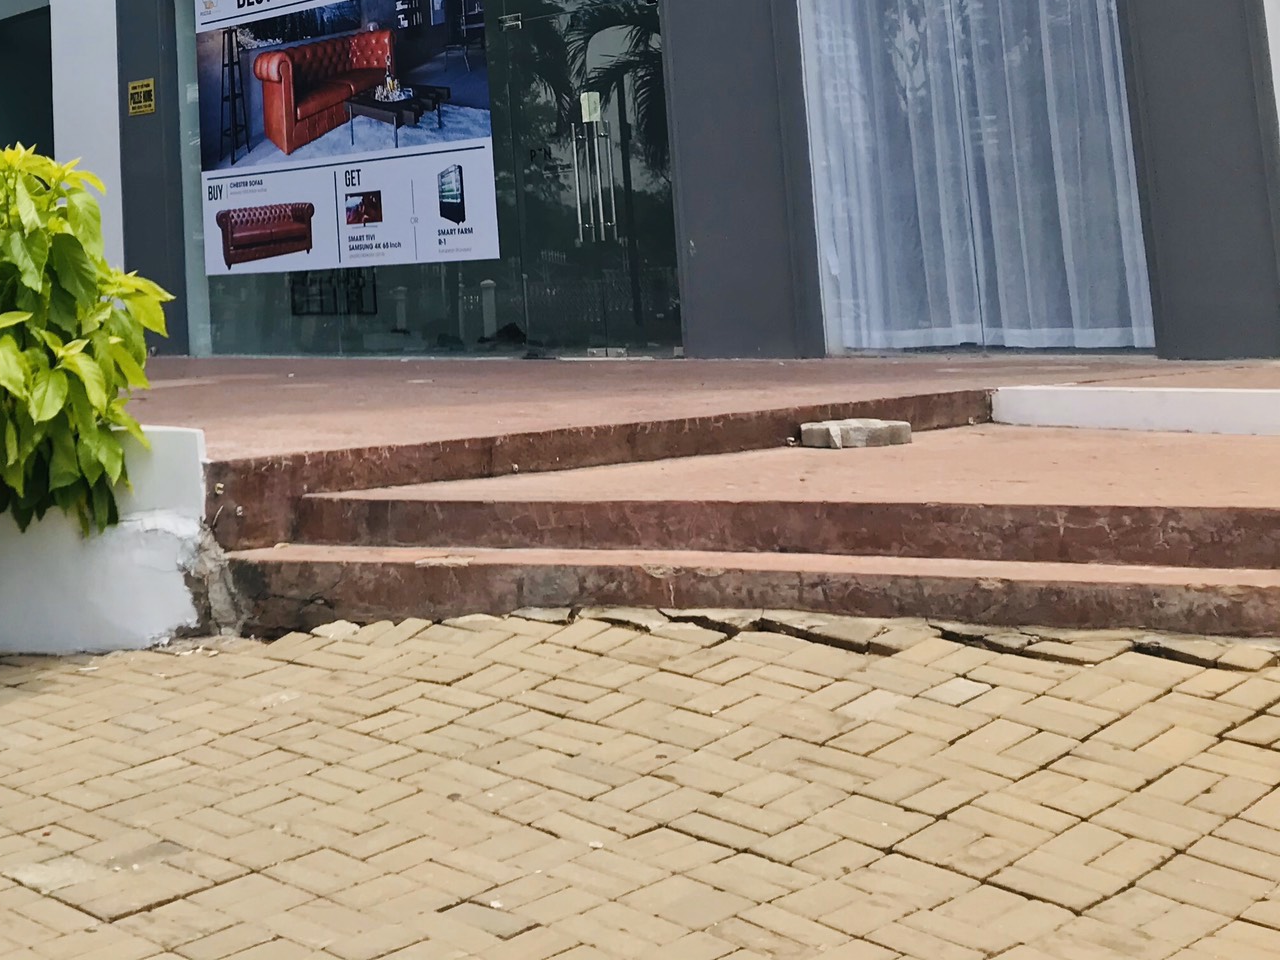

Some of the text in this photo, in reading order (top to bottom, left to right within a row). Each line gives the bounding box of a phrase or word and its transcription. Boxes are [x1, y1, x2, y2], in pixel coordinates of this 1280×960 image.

[344, 169, 361, 187] GET
[248, 179, 263, 187] SOFAS
[208, 184, 223, 201] BUY
[437, 227, 473, 236] SMART FARM
[348, 234, 364, 242] SMART
[348, 243, 374, 251] SAMSUNG
